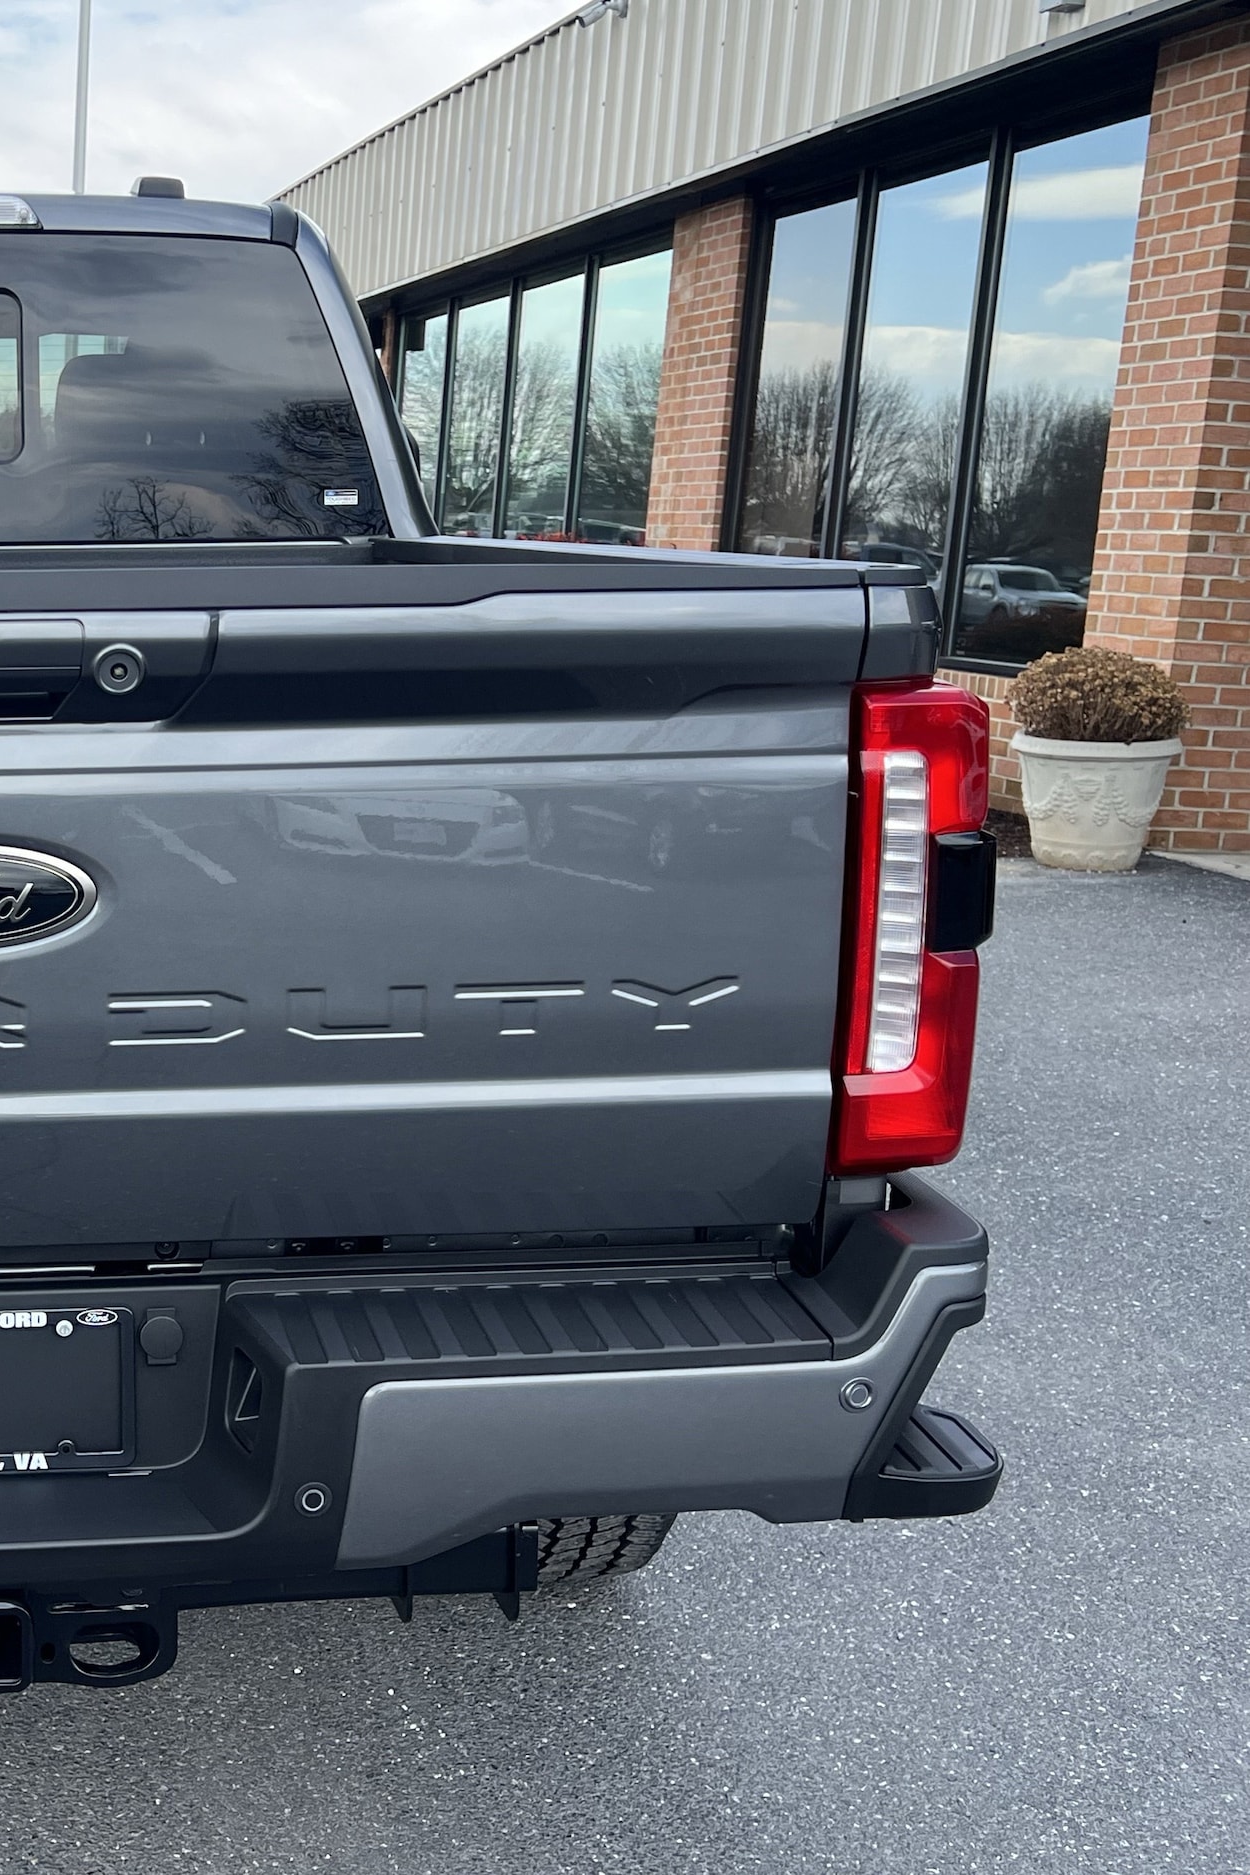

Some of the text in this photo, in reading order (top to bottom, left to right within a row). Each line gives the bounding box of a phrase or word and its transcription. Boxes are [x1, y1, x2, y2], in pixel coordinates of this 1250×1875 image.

[107, 975, 740, 1046] DUTY
[83, 1310, 111, 1324] Ford
[13, 1452, 49, 1471] VA
